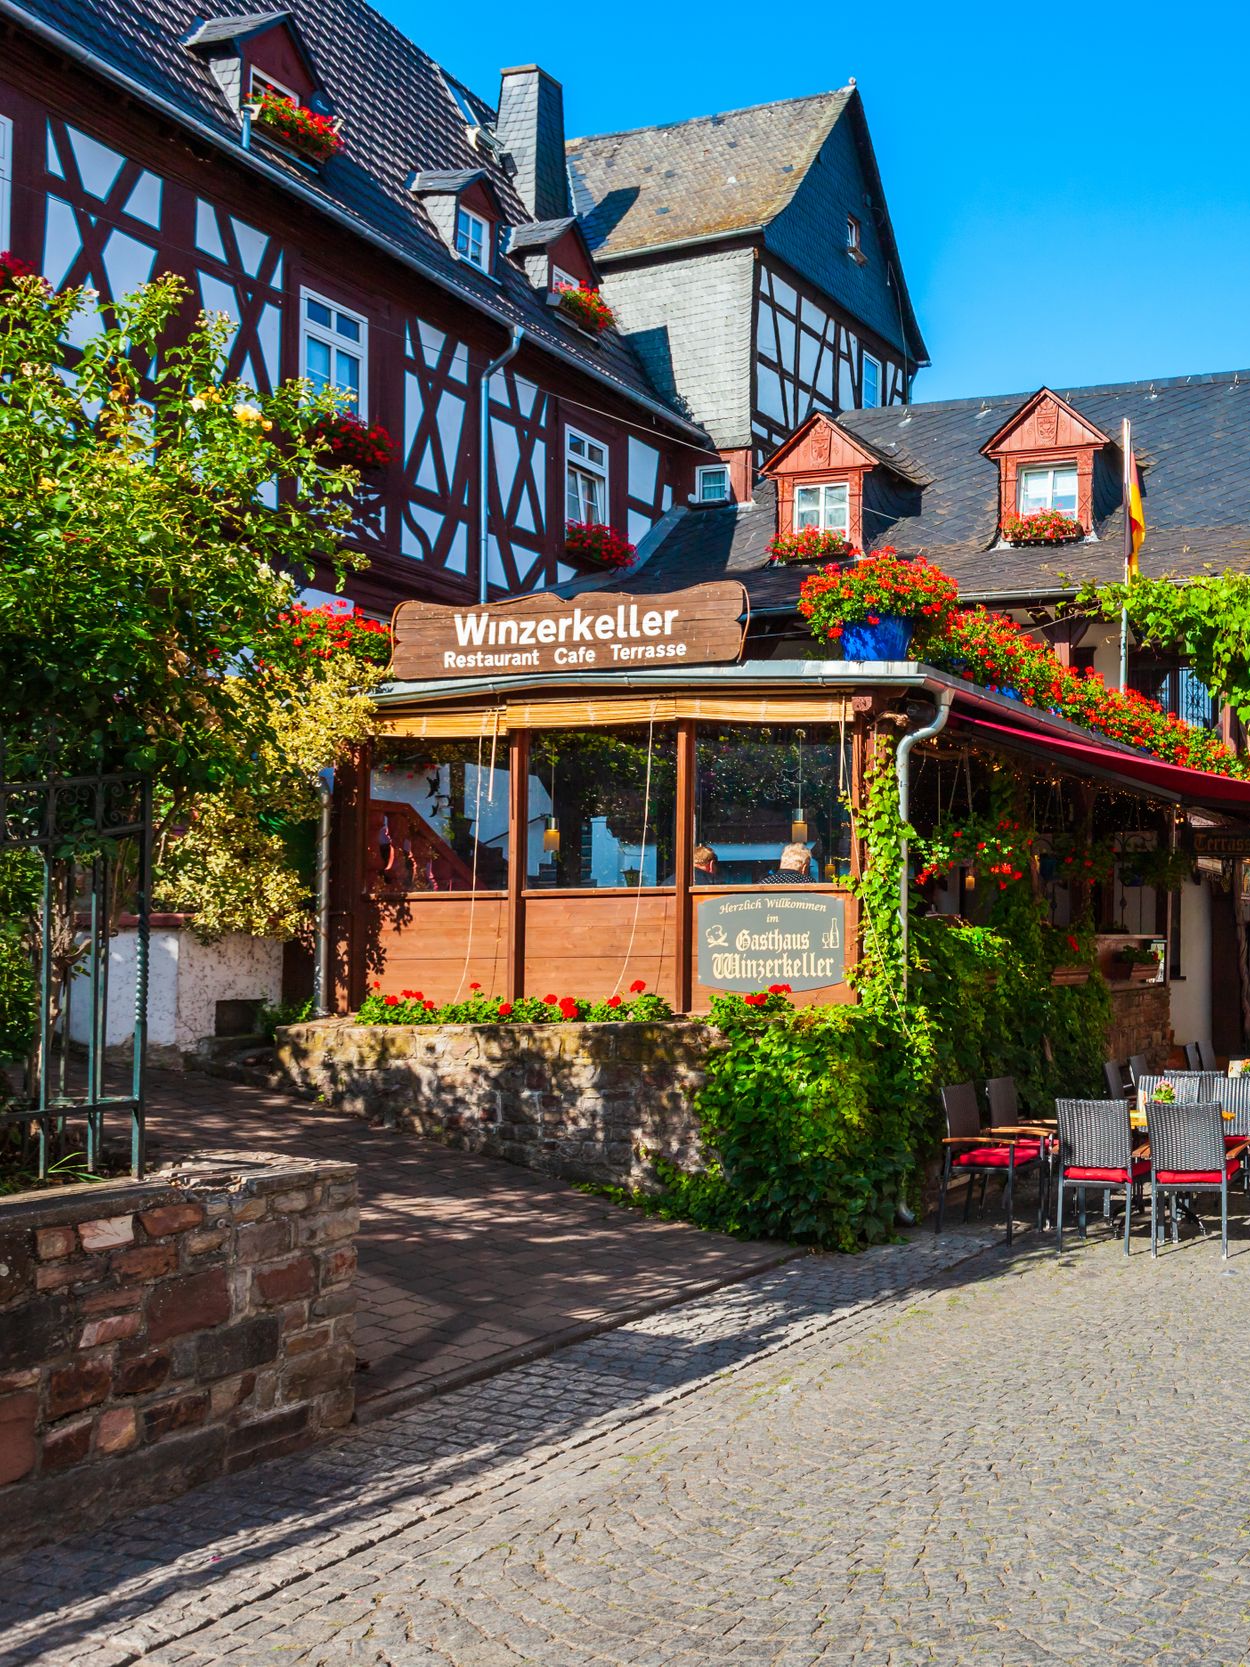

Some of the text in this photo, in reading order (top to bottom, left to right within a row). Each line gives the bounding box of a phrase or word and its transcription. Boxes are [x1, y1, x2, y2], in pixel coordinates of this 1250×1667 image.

[454, 605, 679, 647] Winzerkeller
[443, 643, 687, 669] Restaurant Cafe Terrasse
[719, 897, 827, 915] Herzlich Willkommen
[766, 913, 779, 923] im
[735, 929, 810, 954] Gasthaus
[711, 952, 834, 983] Winzerkeller
